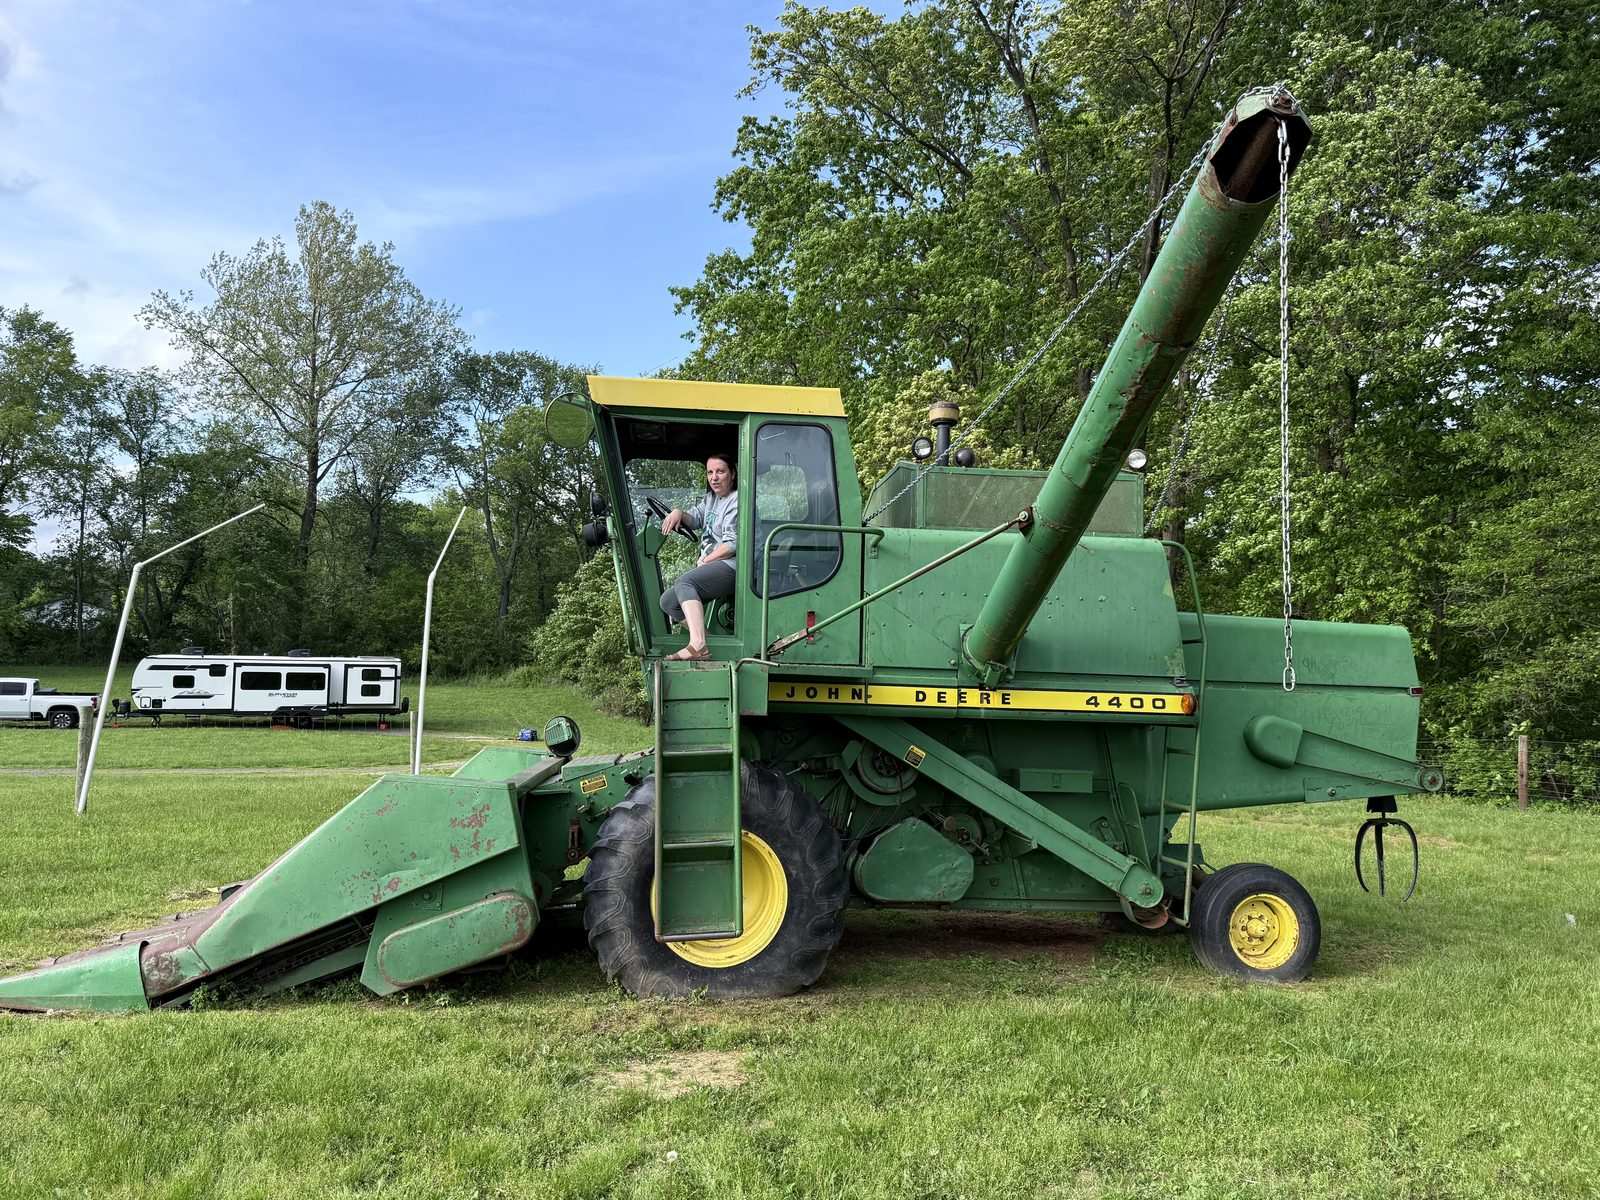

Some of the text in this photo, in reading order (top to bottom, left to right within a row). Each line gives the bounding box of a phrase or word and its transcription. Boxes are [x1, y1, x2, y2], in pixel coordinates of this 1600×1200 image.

[785, 686, 1166, 710] JOHN DEERE 4400
